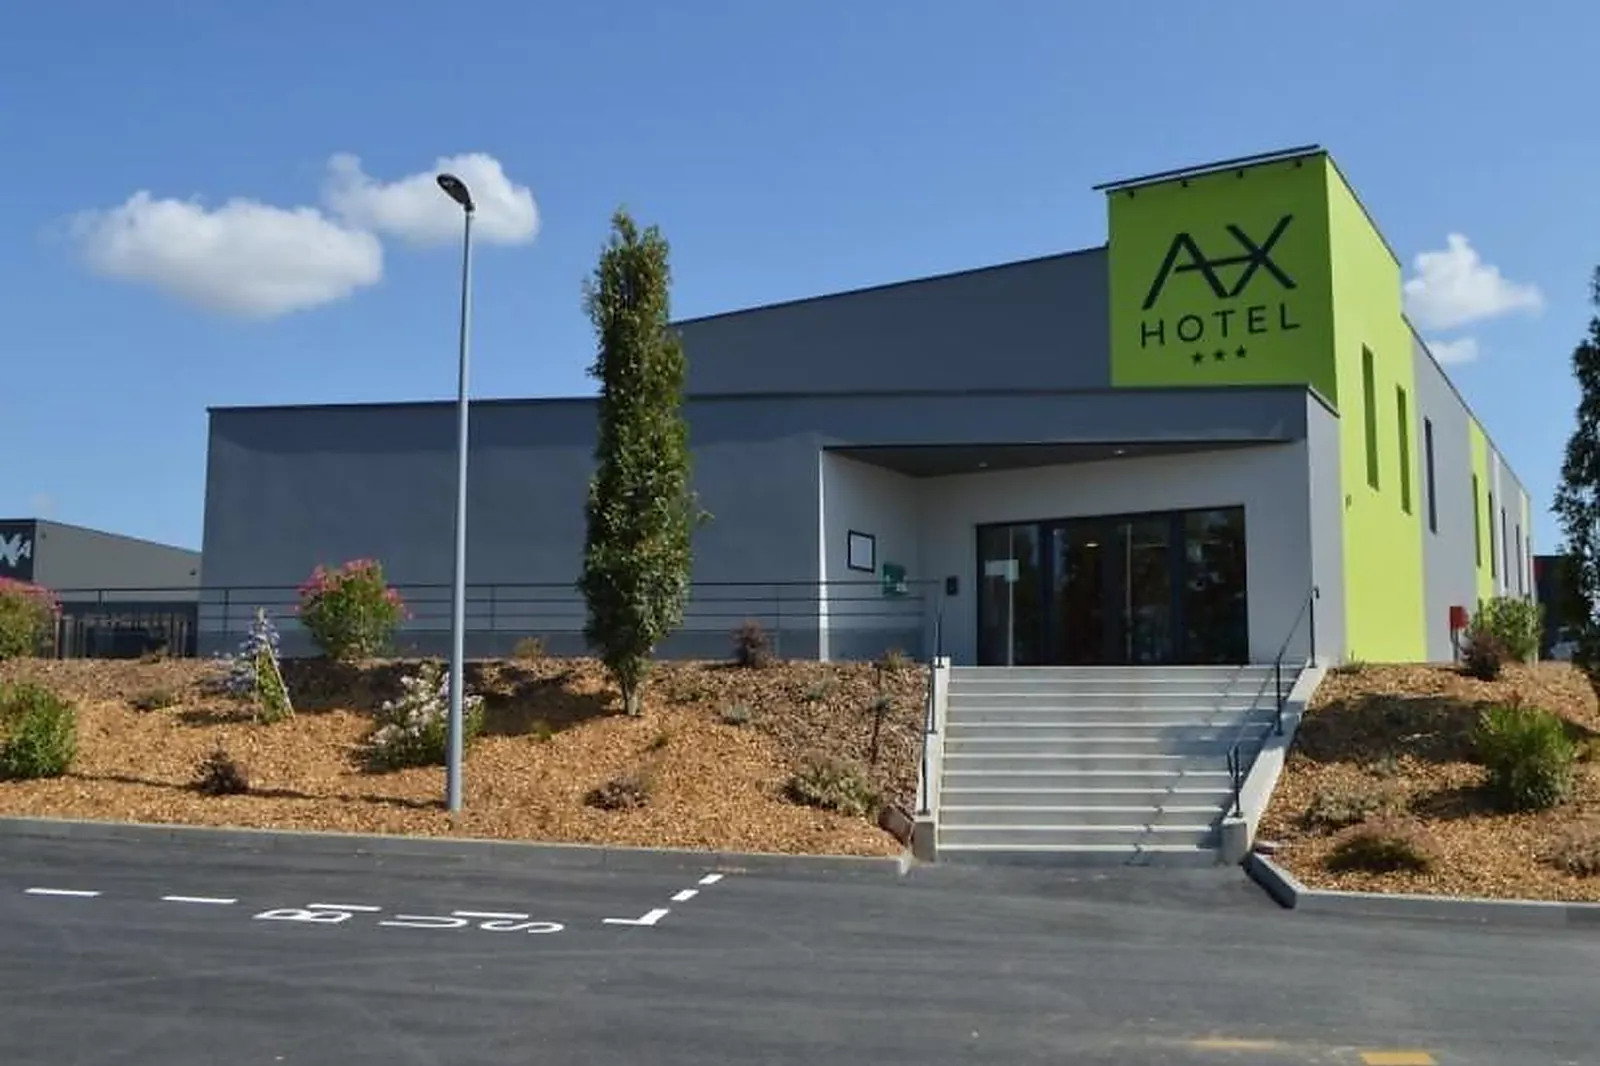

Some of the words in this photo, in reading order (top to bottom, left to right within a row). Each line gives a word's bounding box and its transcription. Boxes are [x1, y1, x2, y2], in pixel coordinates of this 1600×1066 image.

[1142, 214, 1297, 311] AX
[1140, 302, 1301, 349] HOTEL
[253, 908, 565, 934] BUS
